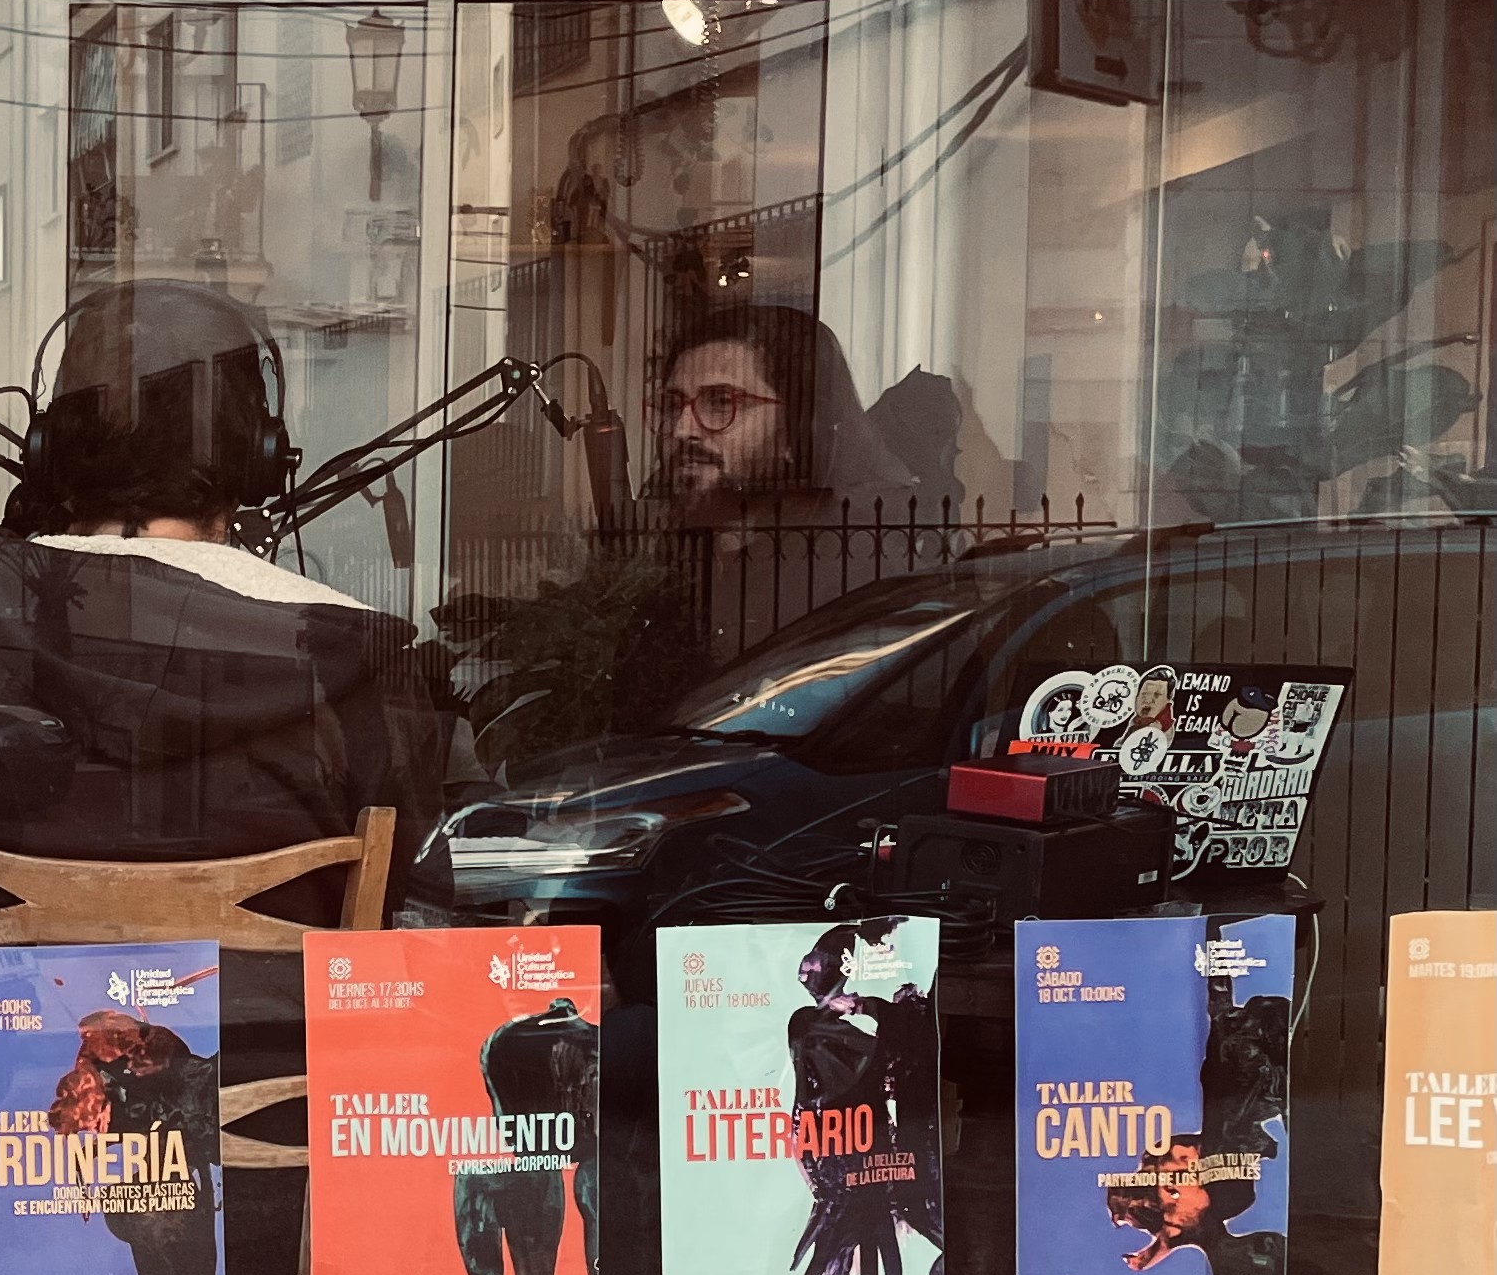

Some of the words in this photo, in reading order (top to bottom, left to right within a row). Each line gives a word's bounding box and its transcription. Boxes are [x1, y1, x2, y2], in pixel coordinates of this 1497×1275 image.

[1185, 694, 1202, 712] IS
[1036, 971, 1082, 987] SÁBADO
[1409, 962, 1456, 978] MARTES
[328, 981, 376, 998] VIERNES
[683, 977, 724, 993] JUEVES
[1038, 988, 1051, 1003] 18
[1079, 985, 1126, 1002] 10:00HS
[328, 998, 343, 1010] DEL
[371, 997, 382, 1008] AL
[685, 995, 696, 1009] 16
[684, 1086, 782, 1111] TALLER
[1036, 1080, 1134, 1105] TALLER
[330, 1093, 430, 1116] TALLER
[1405, 1096, 1484, 1149] LEE
[331, 1117, 371, 1157] EN
[380, 1111, 575, 1157] MOVIMIENTO
[686, 1103, 873, 1162] LITERARIO
[1036, 1105, 1172, 1159] CANTO
[448, 1155, 513, 1175] EXPRESIÓN
[514, 1153, 574, 1172] CORPORAL
[862, 1155, 873, 1169] LA
[874, 1152, 915, 1168] BELLEZA
[1226, 1153, 1238, 1167] TU
[1239, 1152, 1261, 1167] VOZ
[846, 1173, 857, 1187] DE
[859, 1171, 871, 1185] LA
[871, 1166, 915, 1184] LECTURA
[1097, 1172, 1157, 1188] PARTIENDO
[1175, 1171, 1197, 1187] LOS
[53, 1186, 86, 1200] DONDE
[88, 1185, 107, 1199] LAS
[109, 1184, 141, 1199] ARTES
[142, 1181, 195, 1198] PLÁSTICAS
[13, 1200, 28, 1215] SE
[29, 1199, 101, 1215] ENCUENTRAN
[103, 1198, 125, 1213] CON
[126, 1198, 147, 1213] LAS
[148, 1195, 195, 1211] PLANTAS
